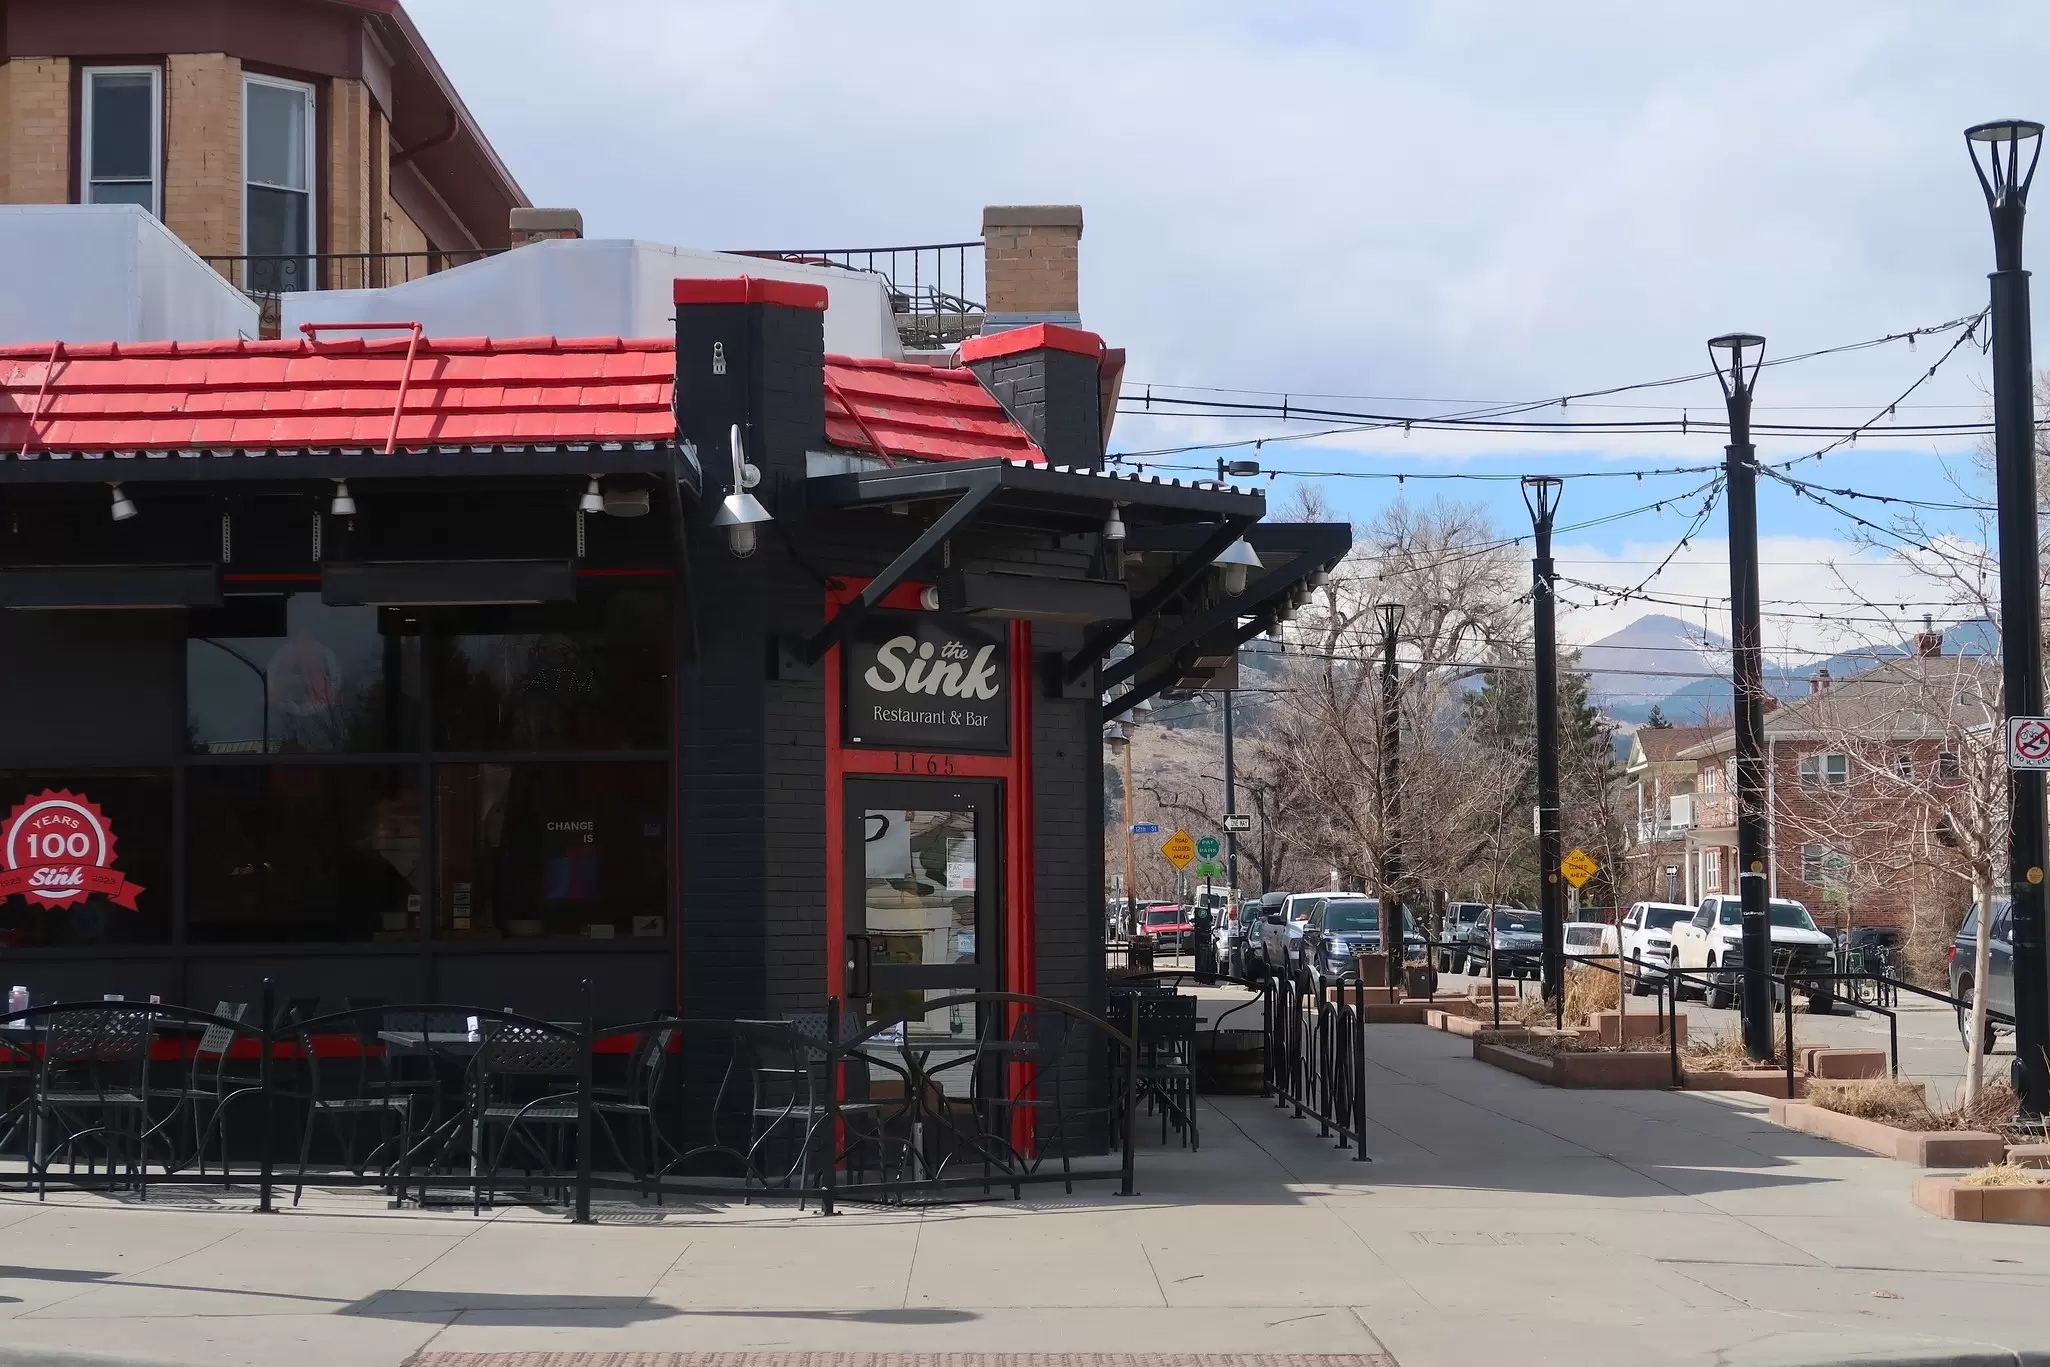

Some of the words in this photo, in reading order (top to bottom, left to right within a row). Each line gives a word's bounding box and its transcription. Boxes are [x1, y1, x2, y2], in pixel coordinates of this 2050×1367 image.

[941, 641, 968, 660] the
[864, 635, 999, 700] Sink
[525, 668, 596, 692] ATM
[874, 705, 945, 725] Restaurant
[950, 711, 961, 725] &
[966, 711, 988, 727] Bar
[894, 752, 954, 775] 1165
[2015, 753, 2024, 762] NO
[33, 815, 79, 829] YEARS
[547, 821, 594, 831] CHANGE
[27, 832, 90, 858] 100
[583, 834, 594, 843] IS
[28, 866, 84, 886] Sink
